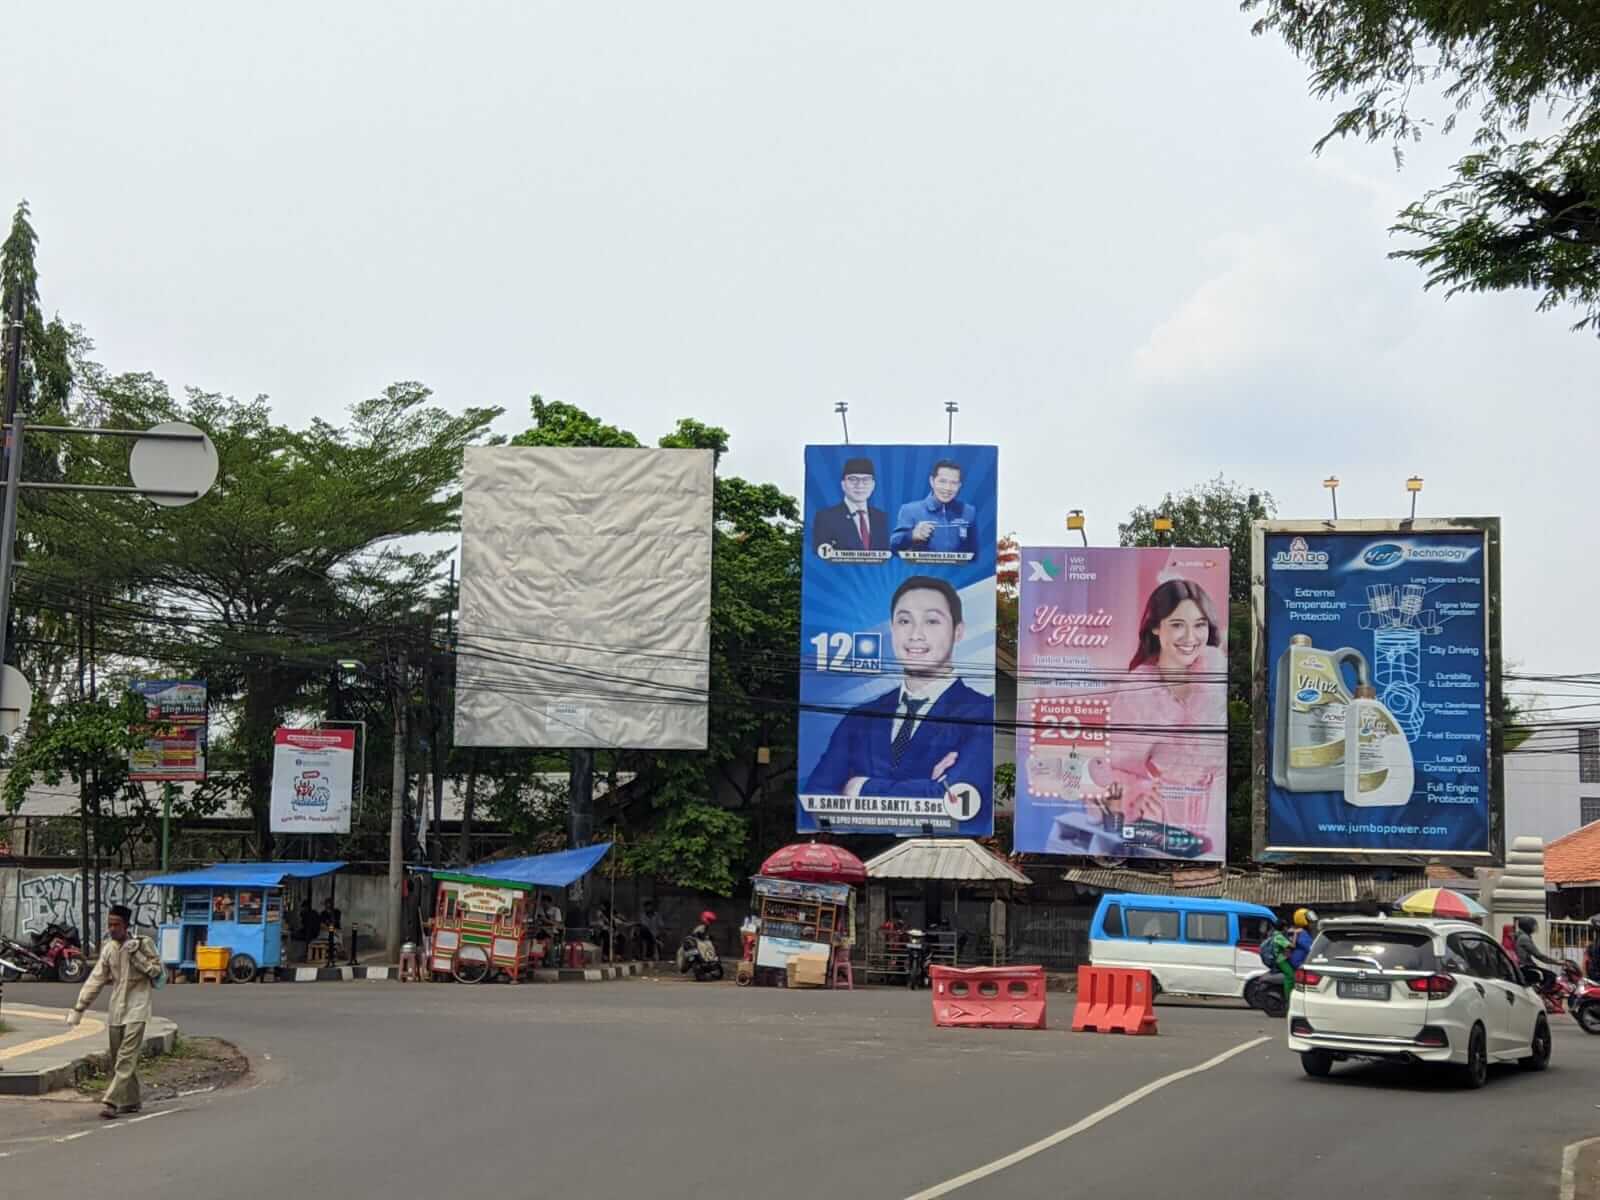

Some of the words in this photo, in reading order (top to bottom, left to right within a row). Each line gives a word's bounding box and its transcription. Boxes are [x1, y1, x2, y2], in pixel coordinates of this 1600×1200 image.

[1408, 549, 1468, 558] Technology
[1295, 587, 1336, 597] Extreme
[1284, 599, 1347, 611] Temperature
[1030, 605, 1113, 632] Yasmin
[1290, 611, 1341, 620] Protection
[1047, 625, 1109, 646] Glam
[810, 632, 852, 672] 12
[1429, 645, 1446, 656] City
[1447, 645, 1479, 656] Driving
[1436, 672, 1472, 681] Durability
[1437, 680, 1480, 688] Lubrication
[1041, 704, 1072, 714] Kuota
[1074, 706, 1105, 716] Besar
[1041, 715, 1081, 739] 20
[1445, 731, 1481, 741] Economy
[1436, 754, 1455, 763] Low
[1456, 754, 1468, 763] Oil
[1423, 763, 1480, 774] Consumption
[1427, 782, 1444, 792] Full
[1446, 782, 1479, 795] Engine
[820, 798, 852, 810] SANDY
[957, 791, 970, 816] 1
[1427, 794, 1479, 804] Protection
[1318, 823, 1448, 835] www.jumbopower.com
